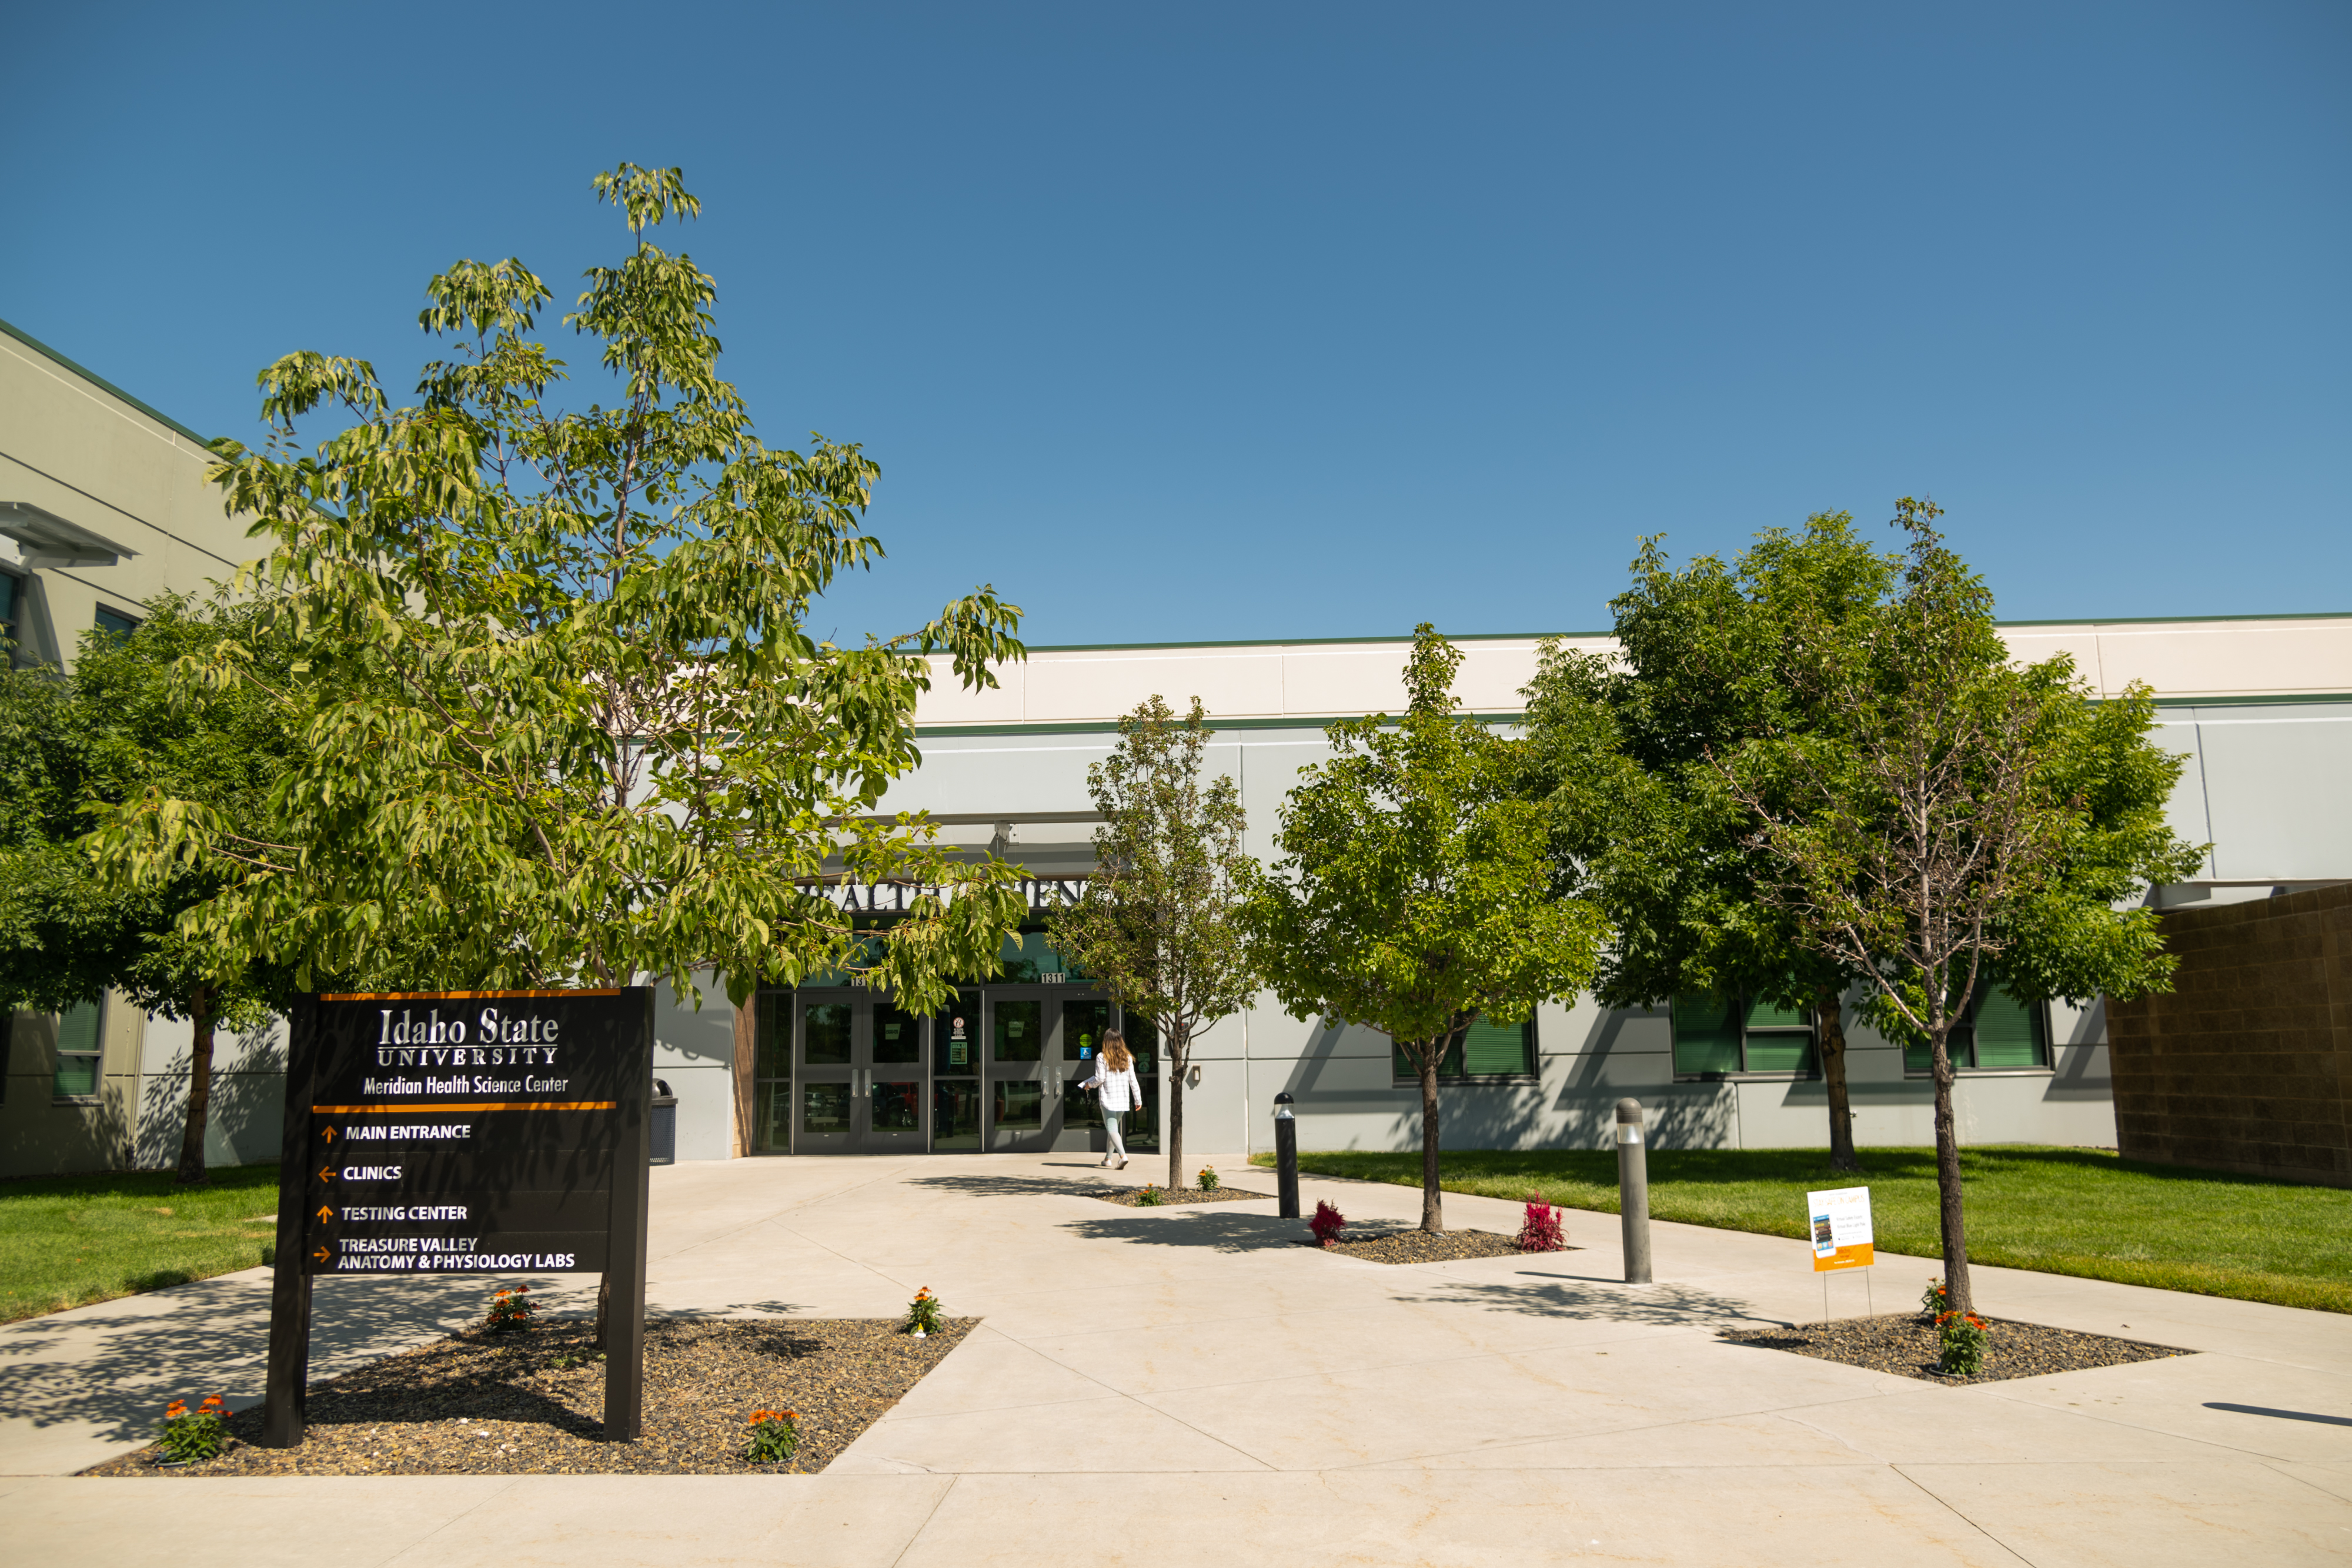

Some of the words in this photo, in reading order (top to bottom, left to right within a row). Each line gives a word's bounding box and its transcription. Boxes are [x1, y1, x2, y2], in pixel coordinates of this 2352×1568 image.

[1043, 973, 1064, 983] 1311
[379, 1009, 466, 1044] Idaho
[480, 1008, 559, 1043] State
[378, 1048, 557, 1066] UNIVERSITY
[364, 1076, 422, 1095] Meridian
[426, 1075, 470, 1094] Health
[474, 1076, 521, 1094] Science
[526, 1075, 569, 1092] Center
[346, 1126, 387, 1140] MAIN
[390, 1125, 471, 1139] ENTRANCE
[343, 1166, 402, 1181] CLINICS
[1813, 1199, 1824, 1207] STAY
[1825, 1197, 1836, 1206] SAFE
[1838, 1196, 1845, 1205] ON
[1845, 1194, 1865, 1203] CAMPUS
[342, 1206, 405, 1221] TESTING
[409, 1206, 467, 1220] CENTER
[339, 1238, 418, 1252] TREASURE
[420, 1238, 478, 1252] VALLEY
[338, 1255, 416, 1269] ANATOMY
[418, 1255, 431, 1269] &
[433, 1254, 533, 1269] PHYSIOLOGY
[536, 1253, 575, 1268] LABS
